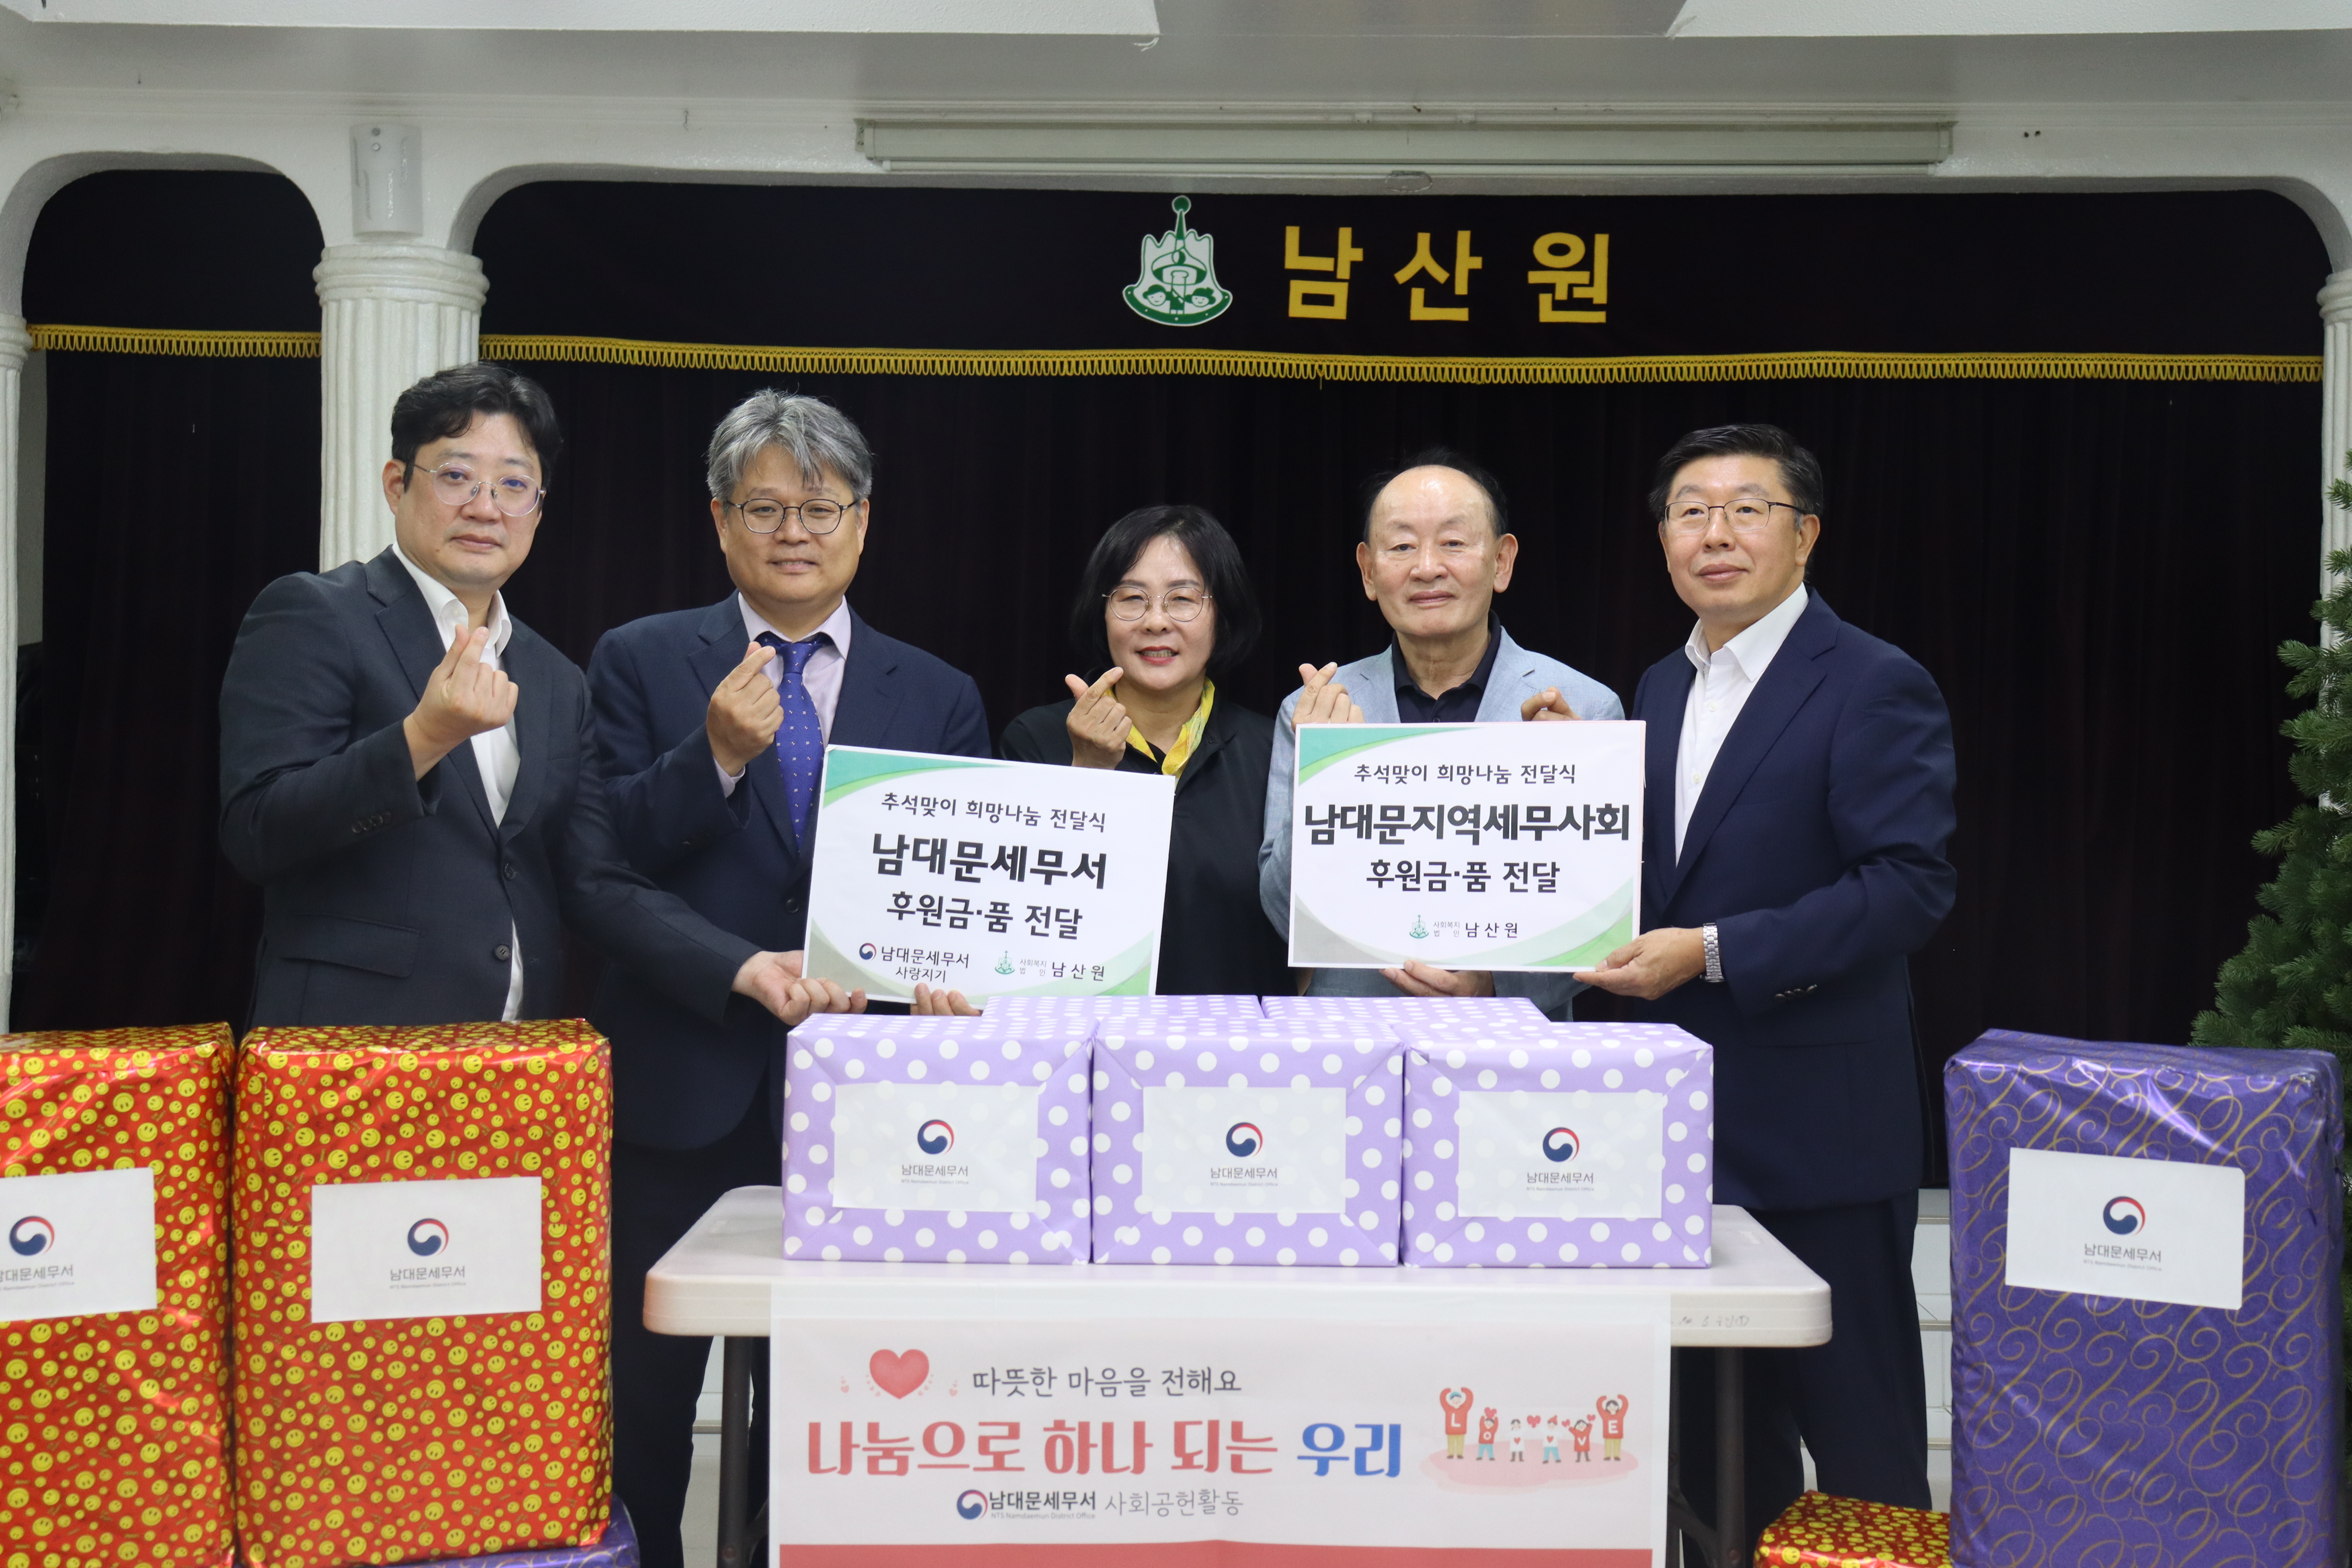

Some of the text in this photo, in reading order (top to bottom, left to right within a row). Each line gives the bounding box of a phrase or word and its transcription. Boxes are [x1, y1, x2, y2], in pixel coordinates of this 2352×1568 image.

[1355, 764, 1575, 785] 추석맞이 희망나눔 전달식
[882, 793, 1105, 833] 추석맞이 희망나눔 전달식
[1305, 804, 1629, 845] 남대문지역세무사회
[873, 834, 1106, 889] 남대문세무서
[1367, 860, 1560, 893] 후원금·품 전달
[887, 891, 1082, 939] 후원금·품 전달
[882, 947, 968, 968] 남대문세무서
[896, 967, 945, 982] 사랑지기
[902, 1165, 967, 1176] 남대문세무서
[1211, 1168, 1277, 1178] 남대문세무서
[1528, 1173, 1593, 1183] 남대문세무서
[2085, 1244, 2161, 1262] 남대문세무서
[391, 1266, 465, 1281] 남대문세무서
[973, 1367, 1241, 1397] 따뜻한 마음을 전해요
[809, 1420, 1401, 1477] 나눔으로 하나 되는 우리
[990, 1489, 1243, 1517] 남대문세무서 사회공헌활동
